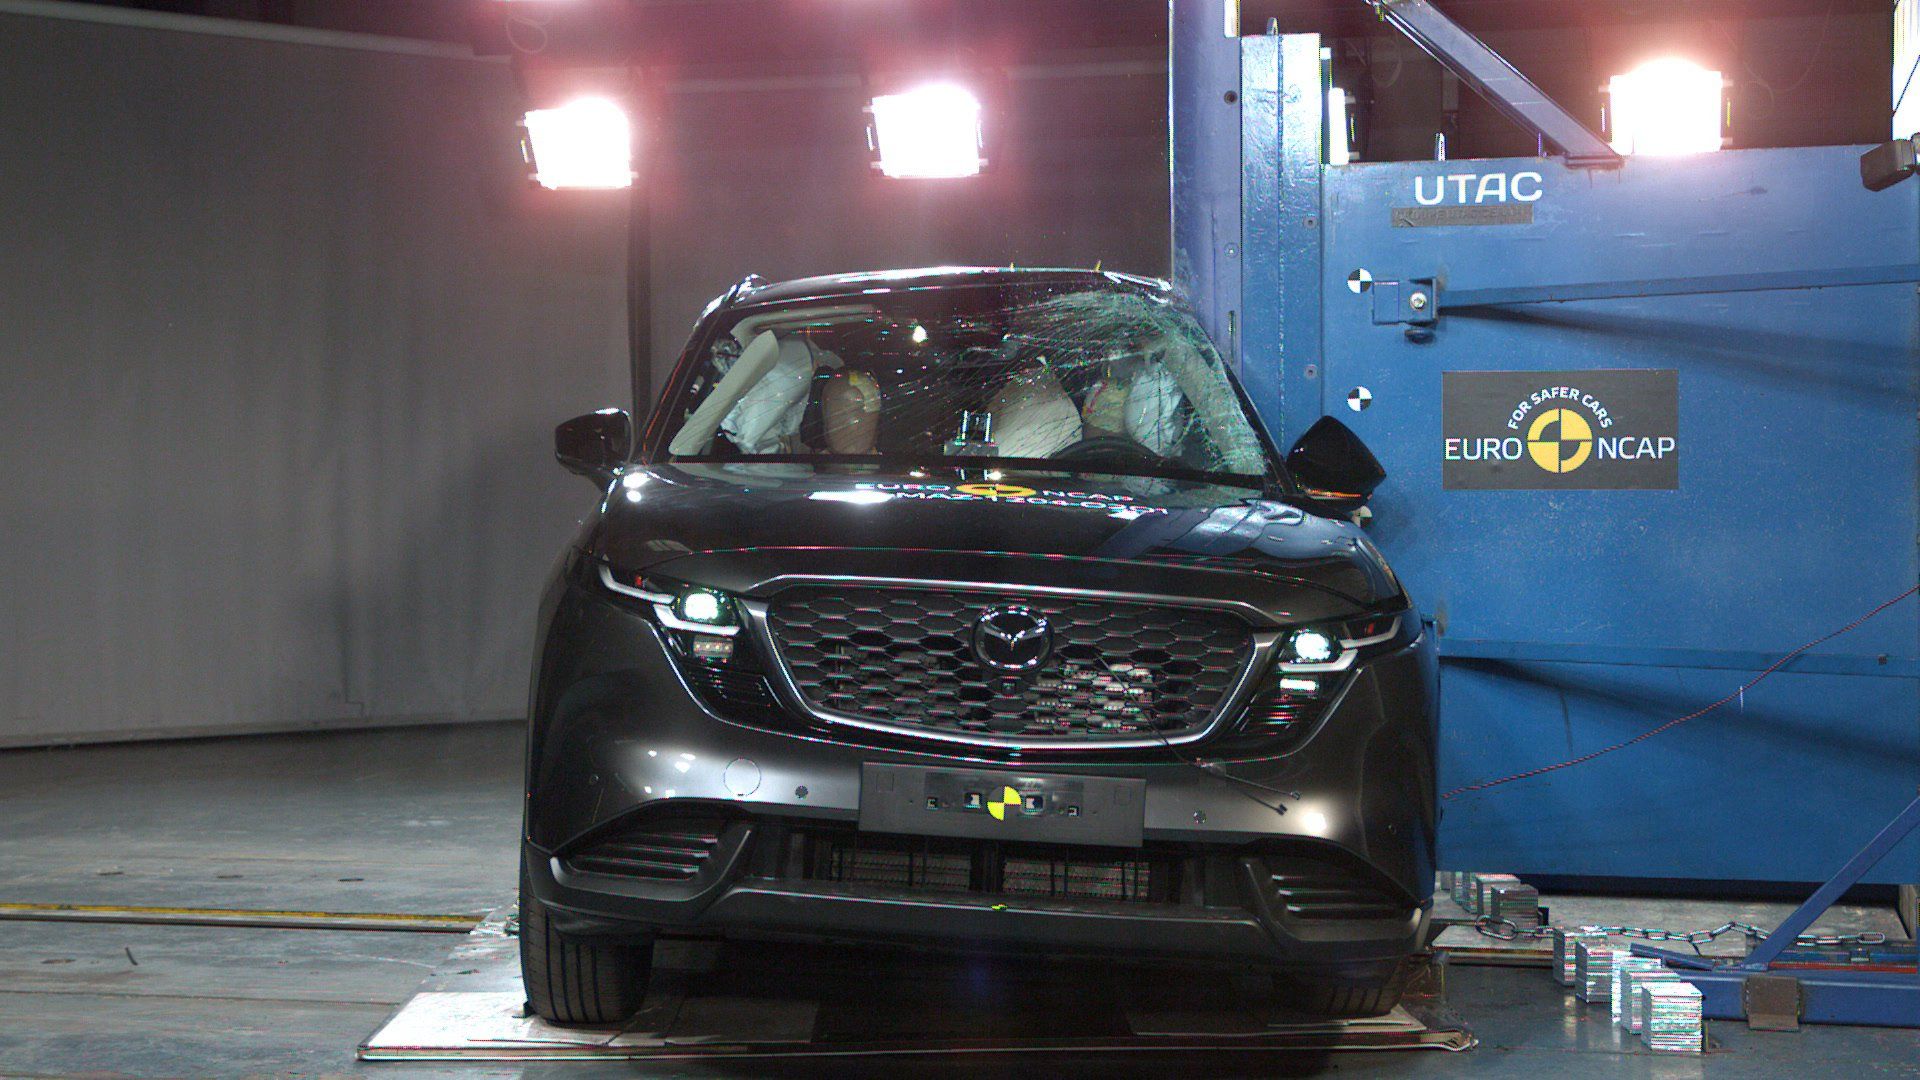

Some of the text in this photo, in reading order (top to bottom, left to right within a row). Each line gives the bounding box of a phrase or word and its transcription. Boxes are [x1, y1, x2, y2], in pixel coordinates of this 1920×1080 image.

[1414, 172, 1543, 205] UTAC
[1507, 386, 1613, 430] FOR SAFER CARS
[1445, 436, 1676, 461] EURO NCAP
[855, 483, 1134, 501] EURO NCAP
